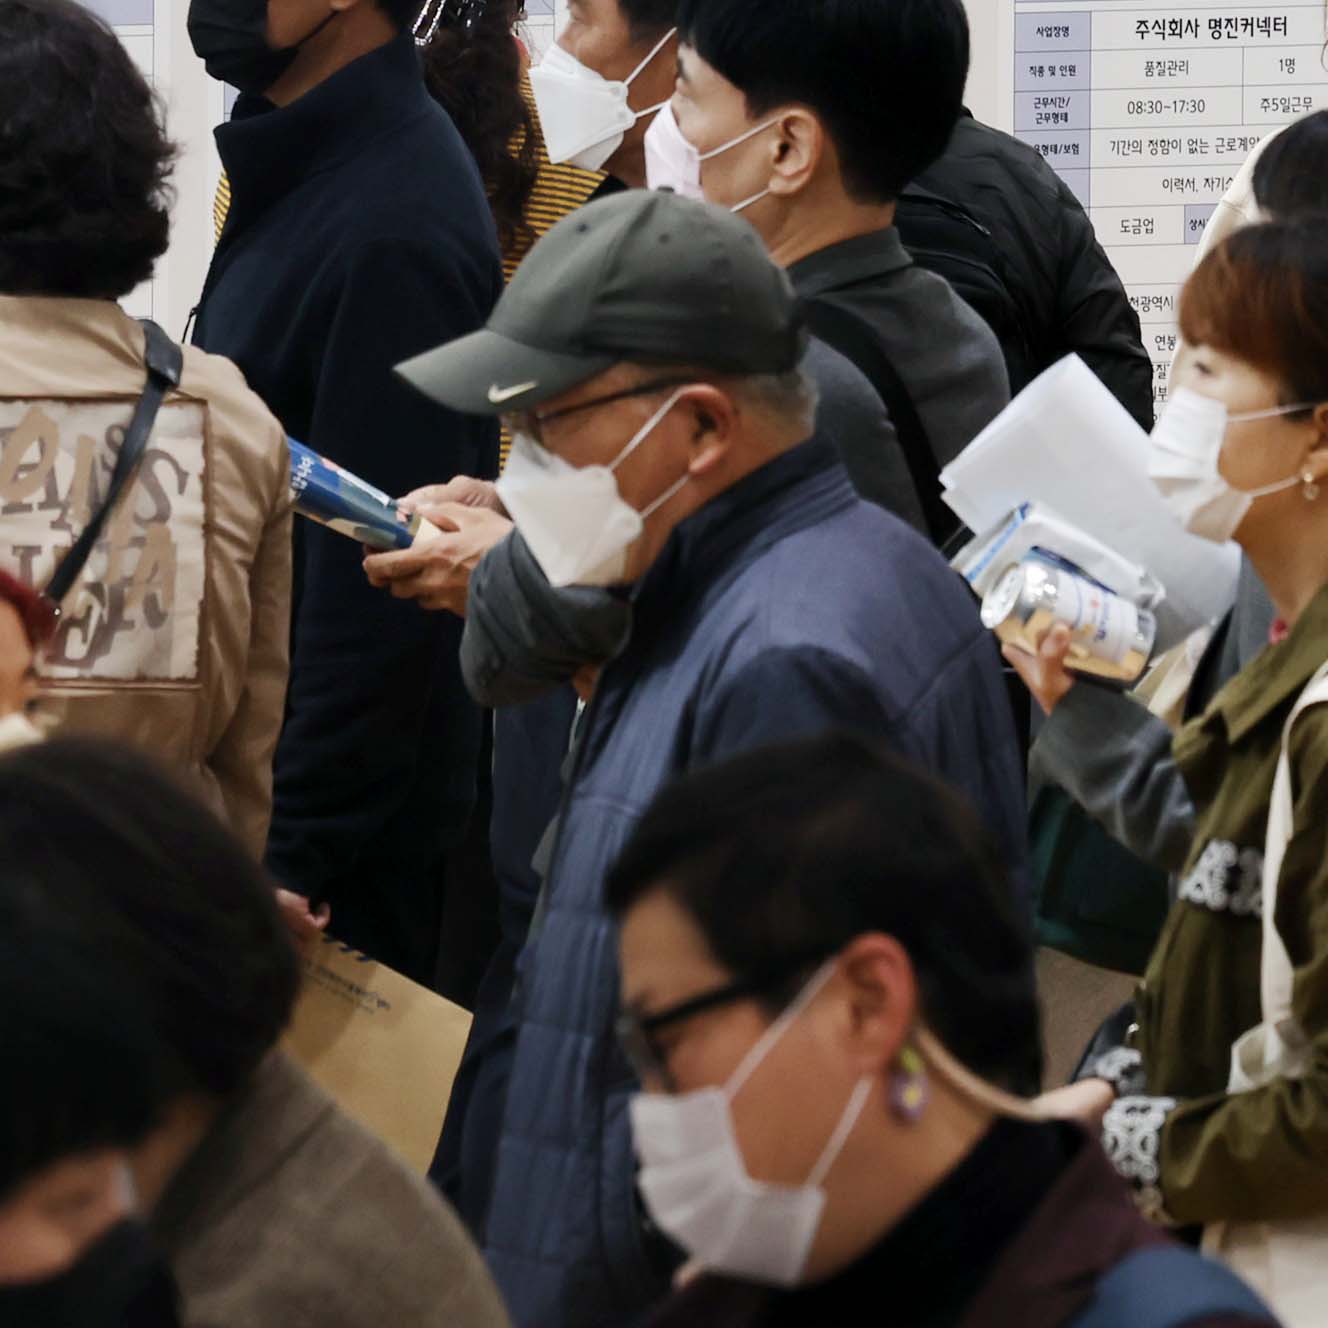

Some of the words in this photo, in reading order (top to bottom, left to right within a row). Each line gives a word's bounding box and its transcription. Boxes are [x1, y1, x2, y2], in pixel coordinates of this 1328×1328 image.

[1135, 17, 1201, 41] 주식회사
[1208, 15, 1287, 41] 명진커넥터
[1144, 59, 1189, 78] 품질관리
[1279, 57, 1296, 75] 1명
[1127, 98, 1206, 115] 08:30~17:30
[1119, 217, 1154, 235] 도금업
